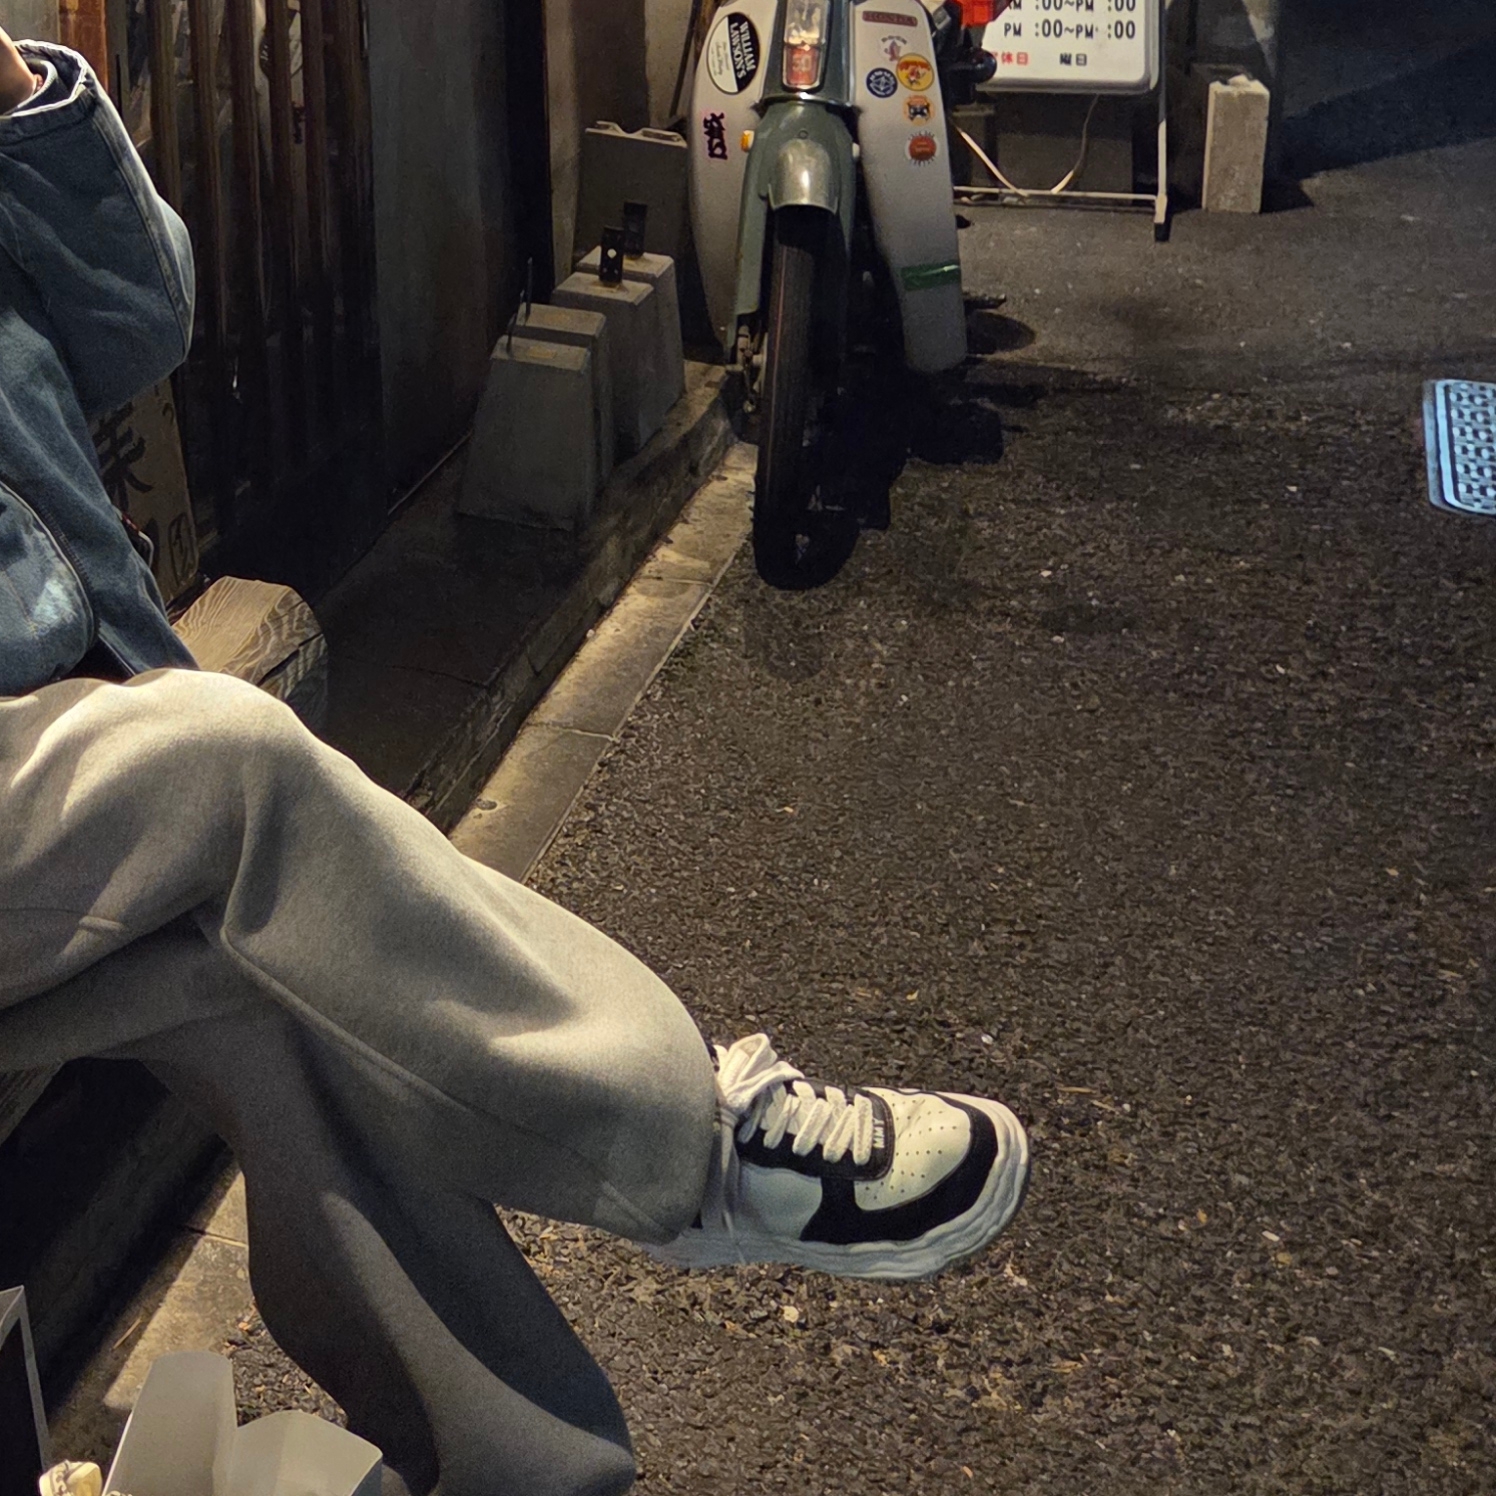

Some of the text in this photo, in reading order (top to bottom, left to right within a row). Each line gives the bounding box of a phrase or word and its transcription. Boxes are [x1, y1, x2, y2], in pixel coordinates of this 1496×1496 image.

[1004, 22, 1022, 38] PM
[1107, 20, 1136, 40] :00
[739, 21, 756, 71] WILLIAM
[992, 51, 1028, 65] 休日
